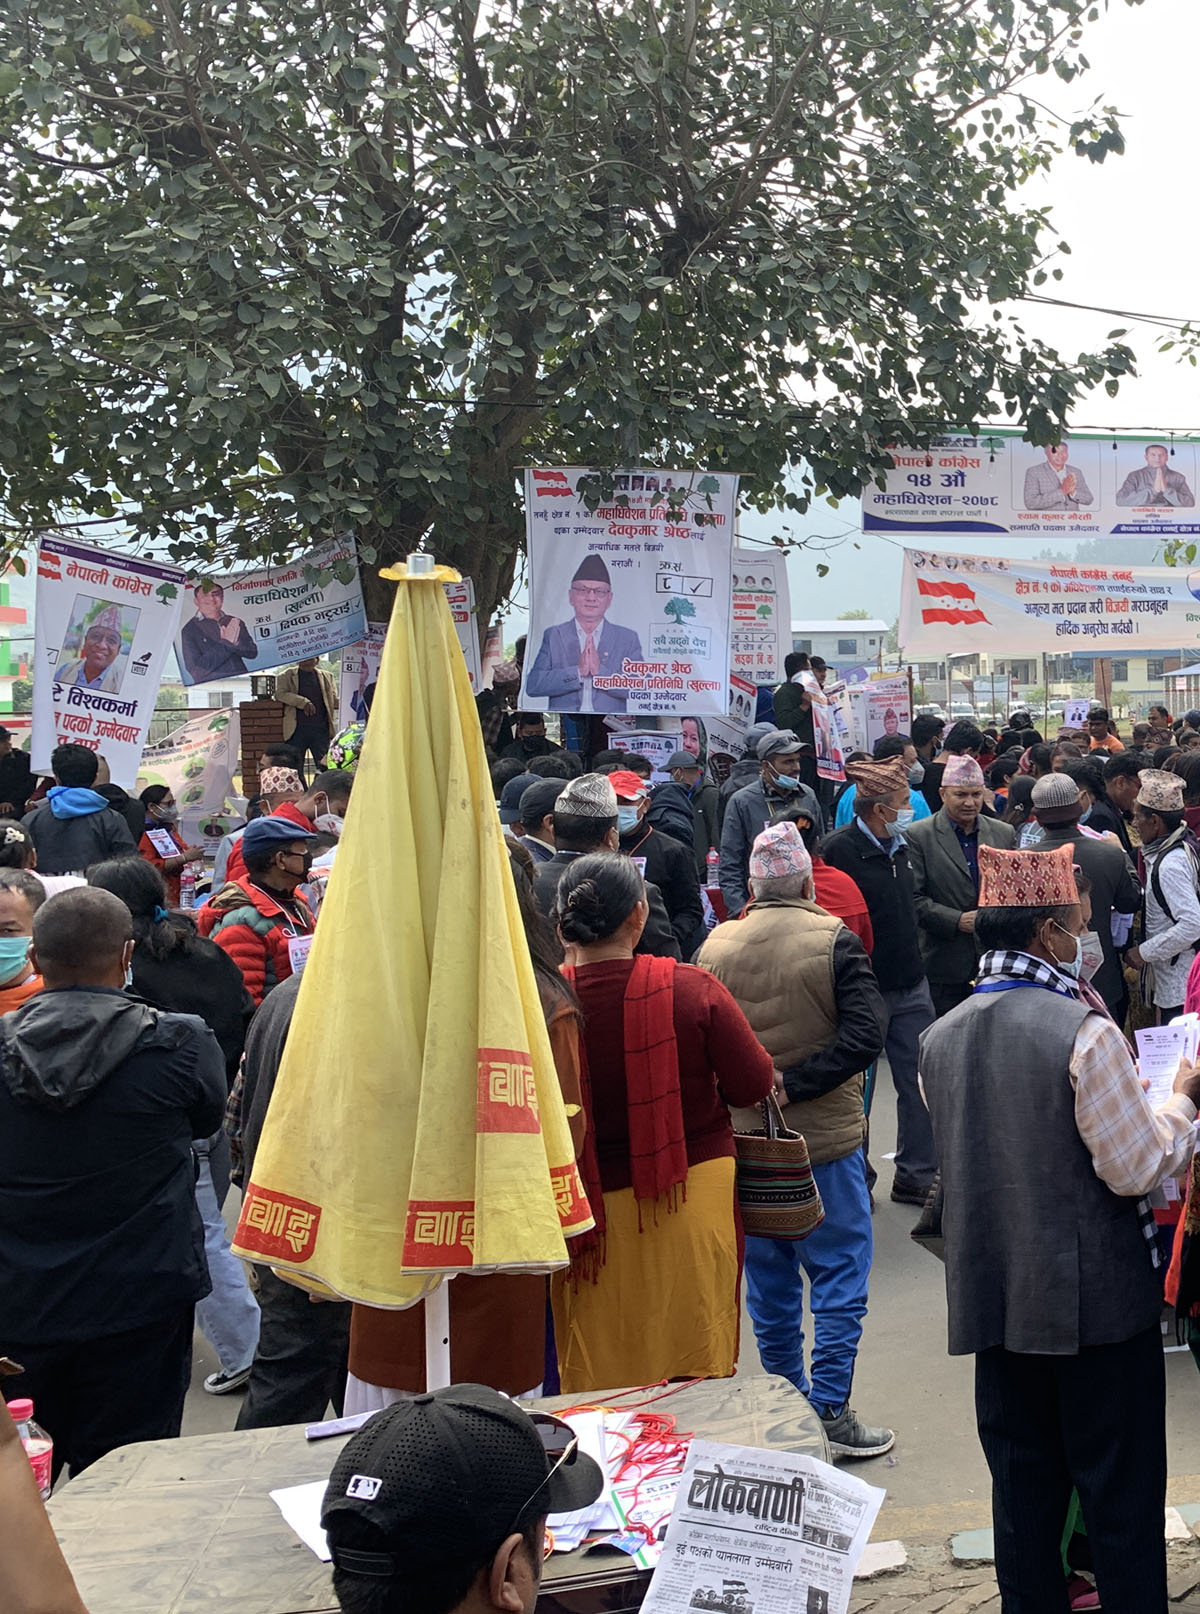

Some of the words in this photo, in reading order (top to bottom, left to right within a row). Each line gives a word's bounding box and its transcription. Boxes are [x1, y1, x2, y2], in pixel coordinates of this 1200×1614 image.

[907, 473, 931, 487] १४
[597, 506, 646, 521] महाधिवेशन
[66, 561, 110, 586] नेपाली
[112, 573, 153, 596] कांग्रेस
[243, 582, 309, 606] महाधिवेशन
[1052, 604, 1064, 615] मत
[1067, 603, 1086, 615] प्रदान
[1082, 620, 1109, 638] अनुरोध
[623, 659, 668, 676] देवकुमार
[593, 675, 644, 690] महाधिवेशन
[647, 676, 684, 690] प्रतिनिधि
[66, 687, 138, 717] विश्वकर्मा
[62, 713, 93, 735] पदको
[93, 718, 142, 744] उम्मेदवार
[687, 1464, 806, 1526] लोकवाणी
